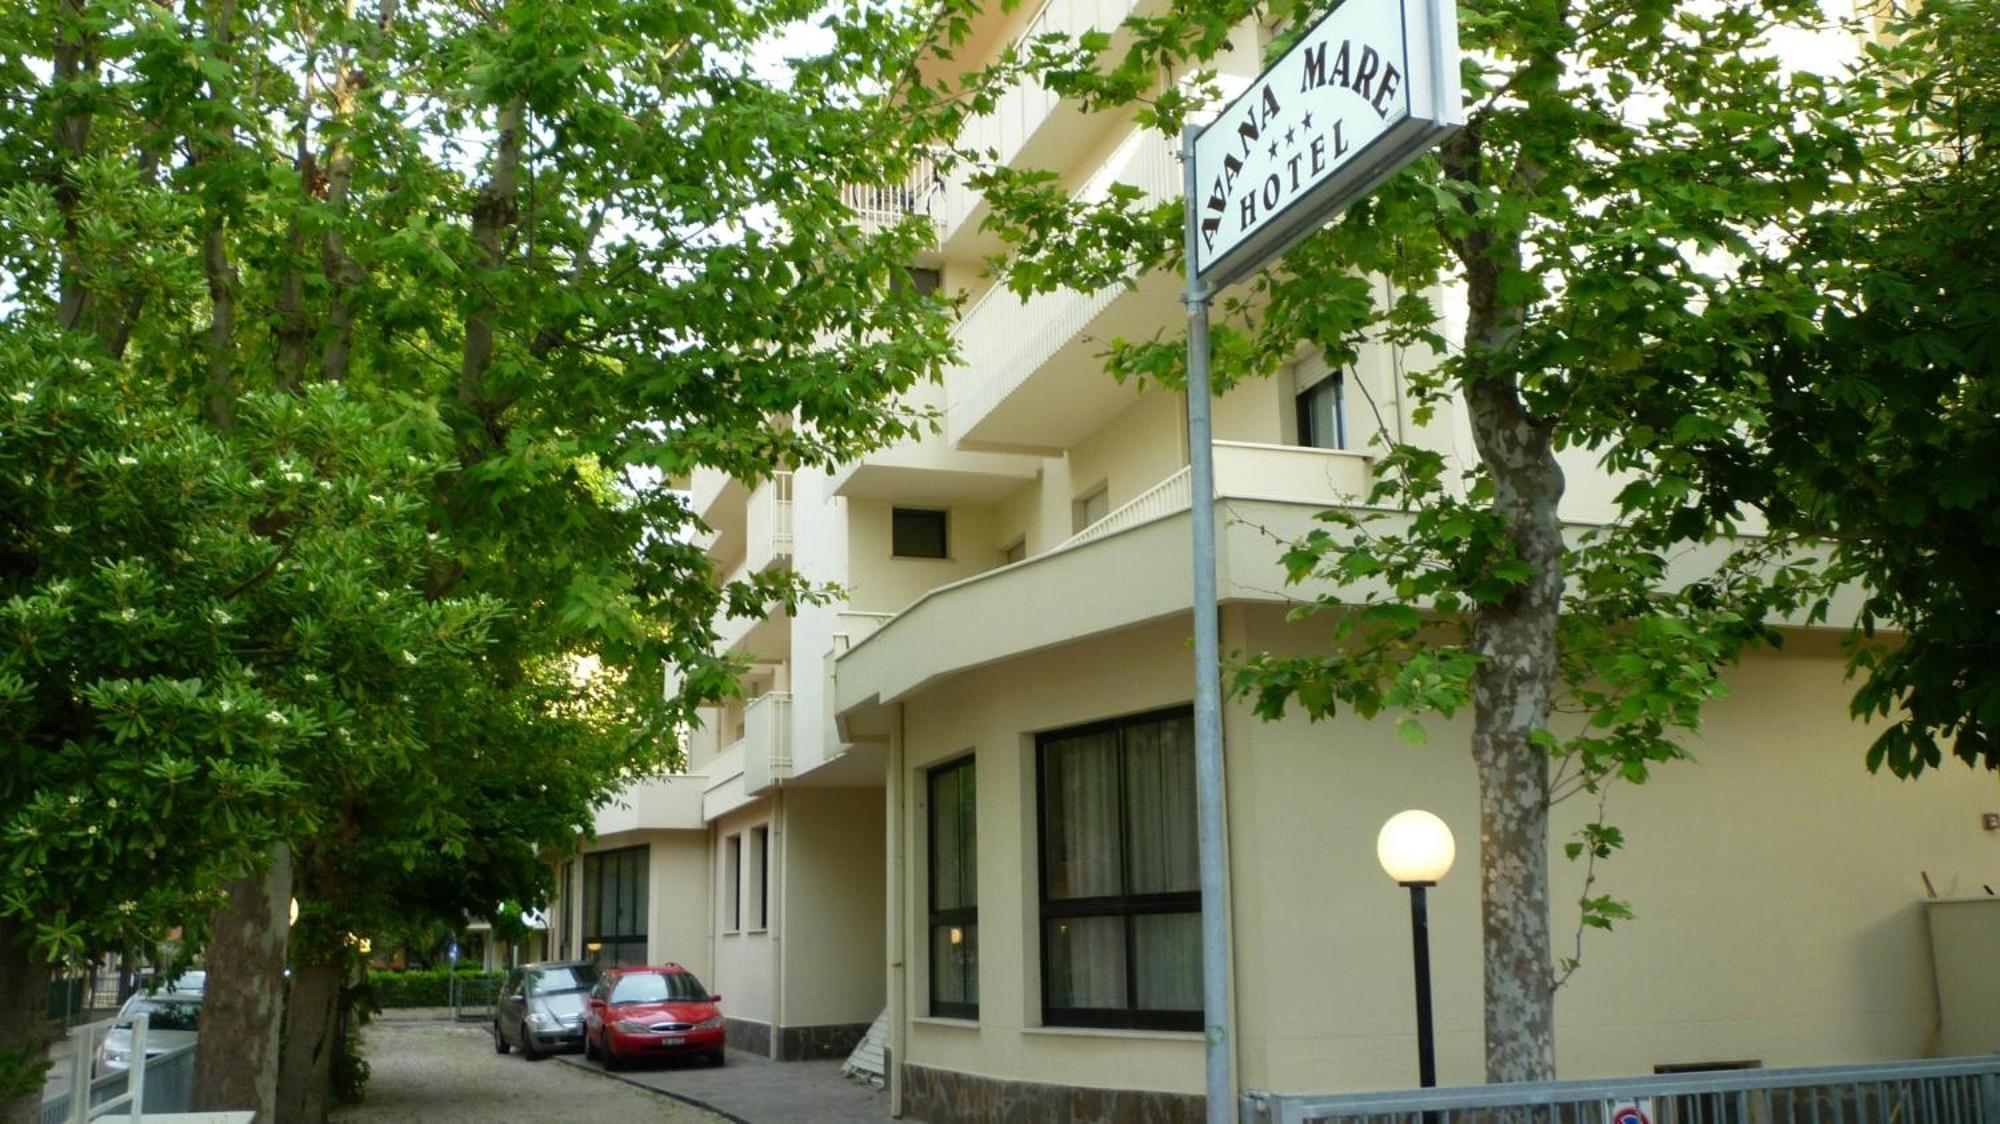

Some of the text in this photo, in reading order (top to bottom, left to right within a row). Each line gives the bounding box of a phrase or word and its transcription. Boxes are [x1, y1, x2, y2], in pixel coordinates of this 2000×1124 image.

[1202, 40, 1400, 255] AVANA MARE
[1239, 118, 1349, 232] HOTEL
